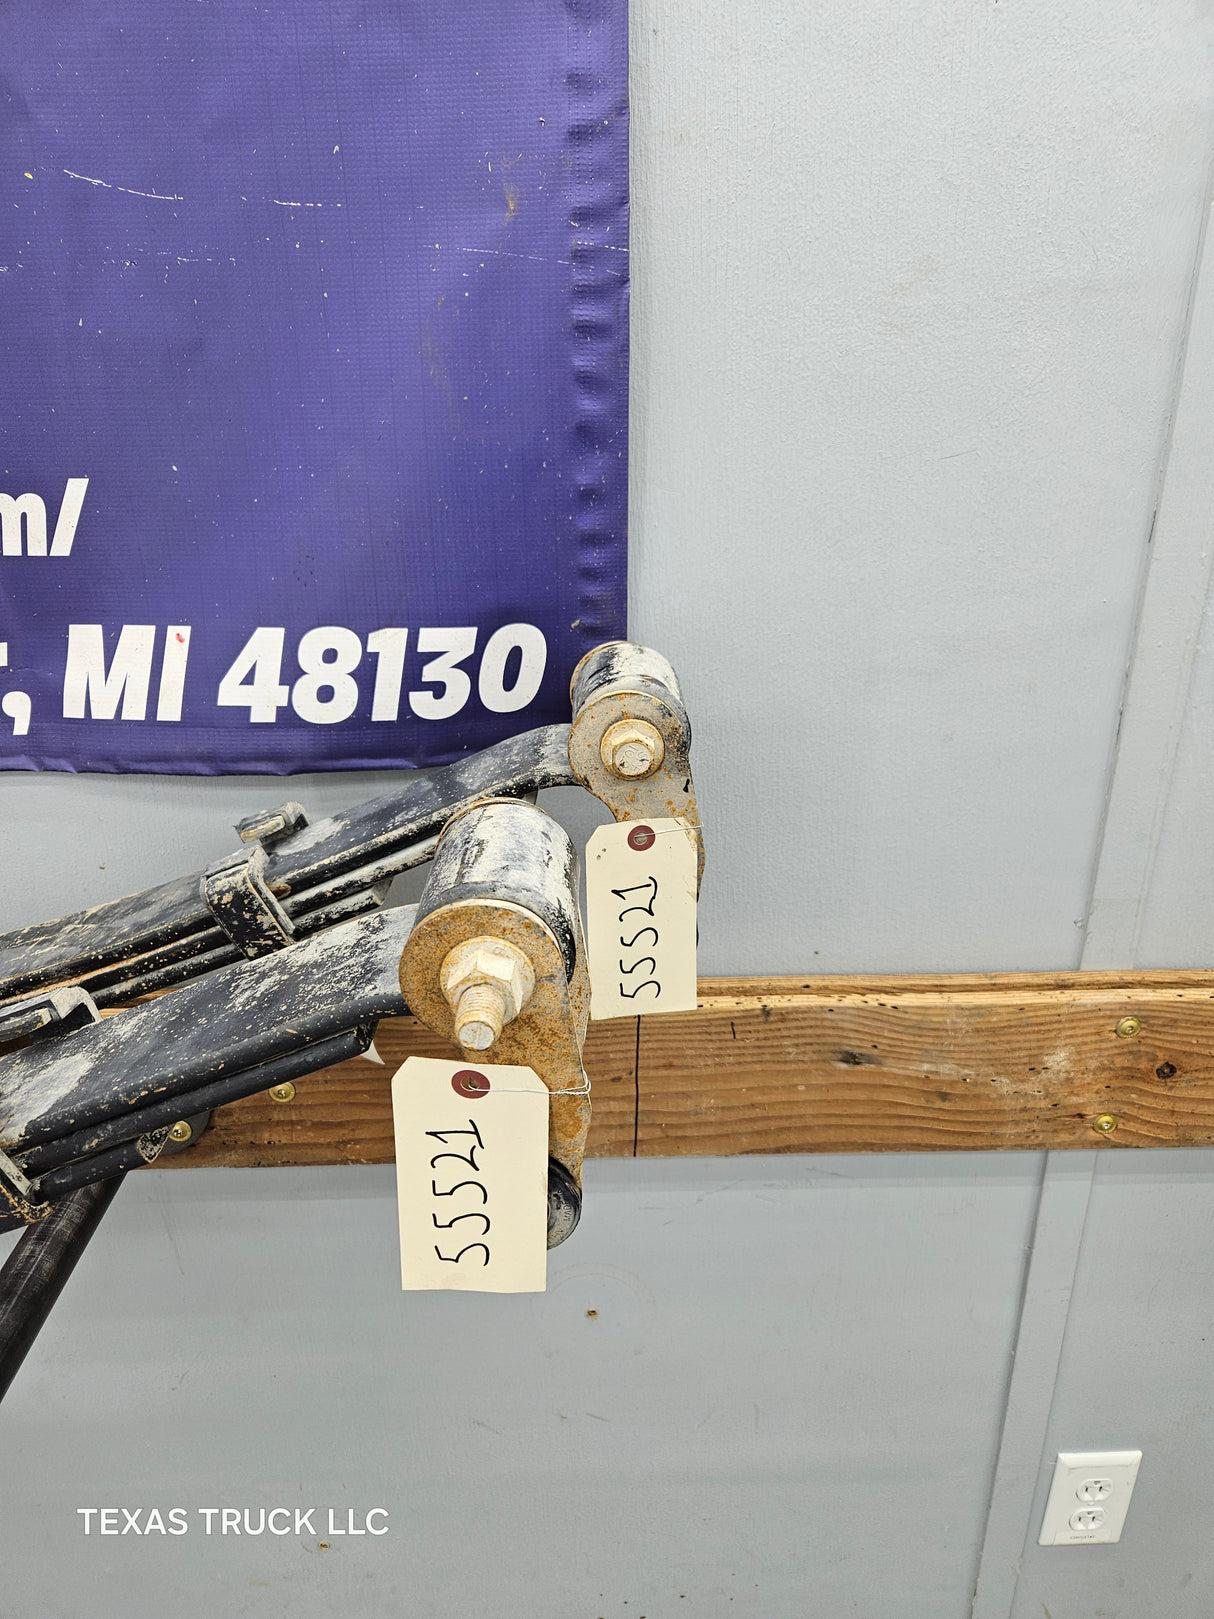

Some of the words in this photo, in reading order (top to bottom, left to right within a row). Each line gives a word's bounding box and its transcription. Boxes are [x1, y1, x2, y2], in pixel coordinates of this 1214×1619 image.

[63, 624, 192, 722] MI
[217, 623, 548, 725] 48130
[610, 875, 662, 999] 55521
[425, 1118, 491, 1268] 55521
